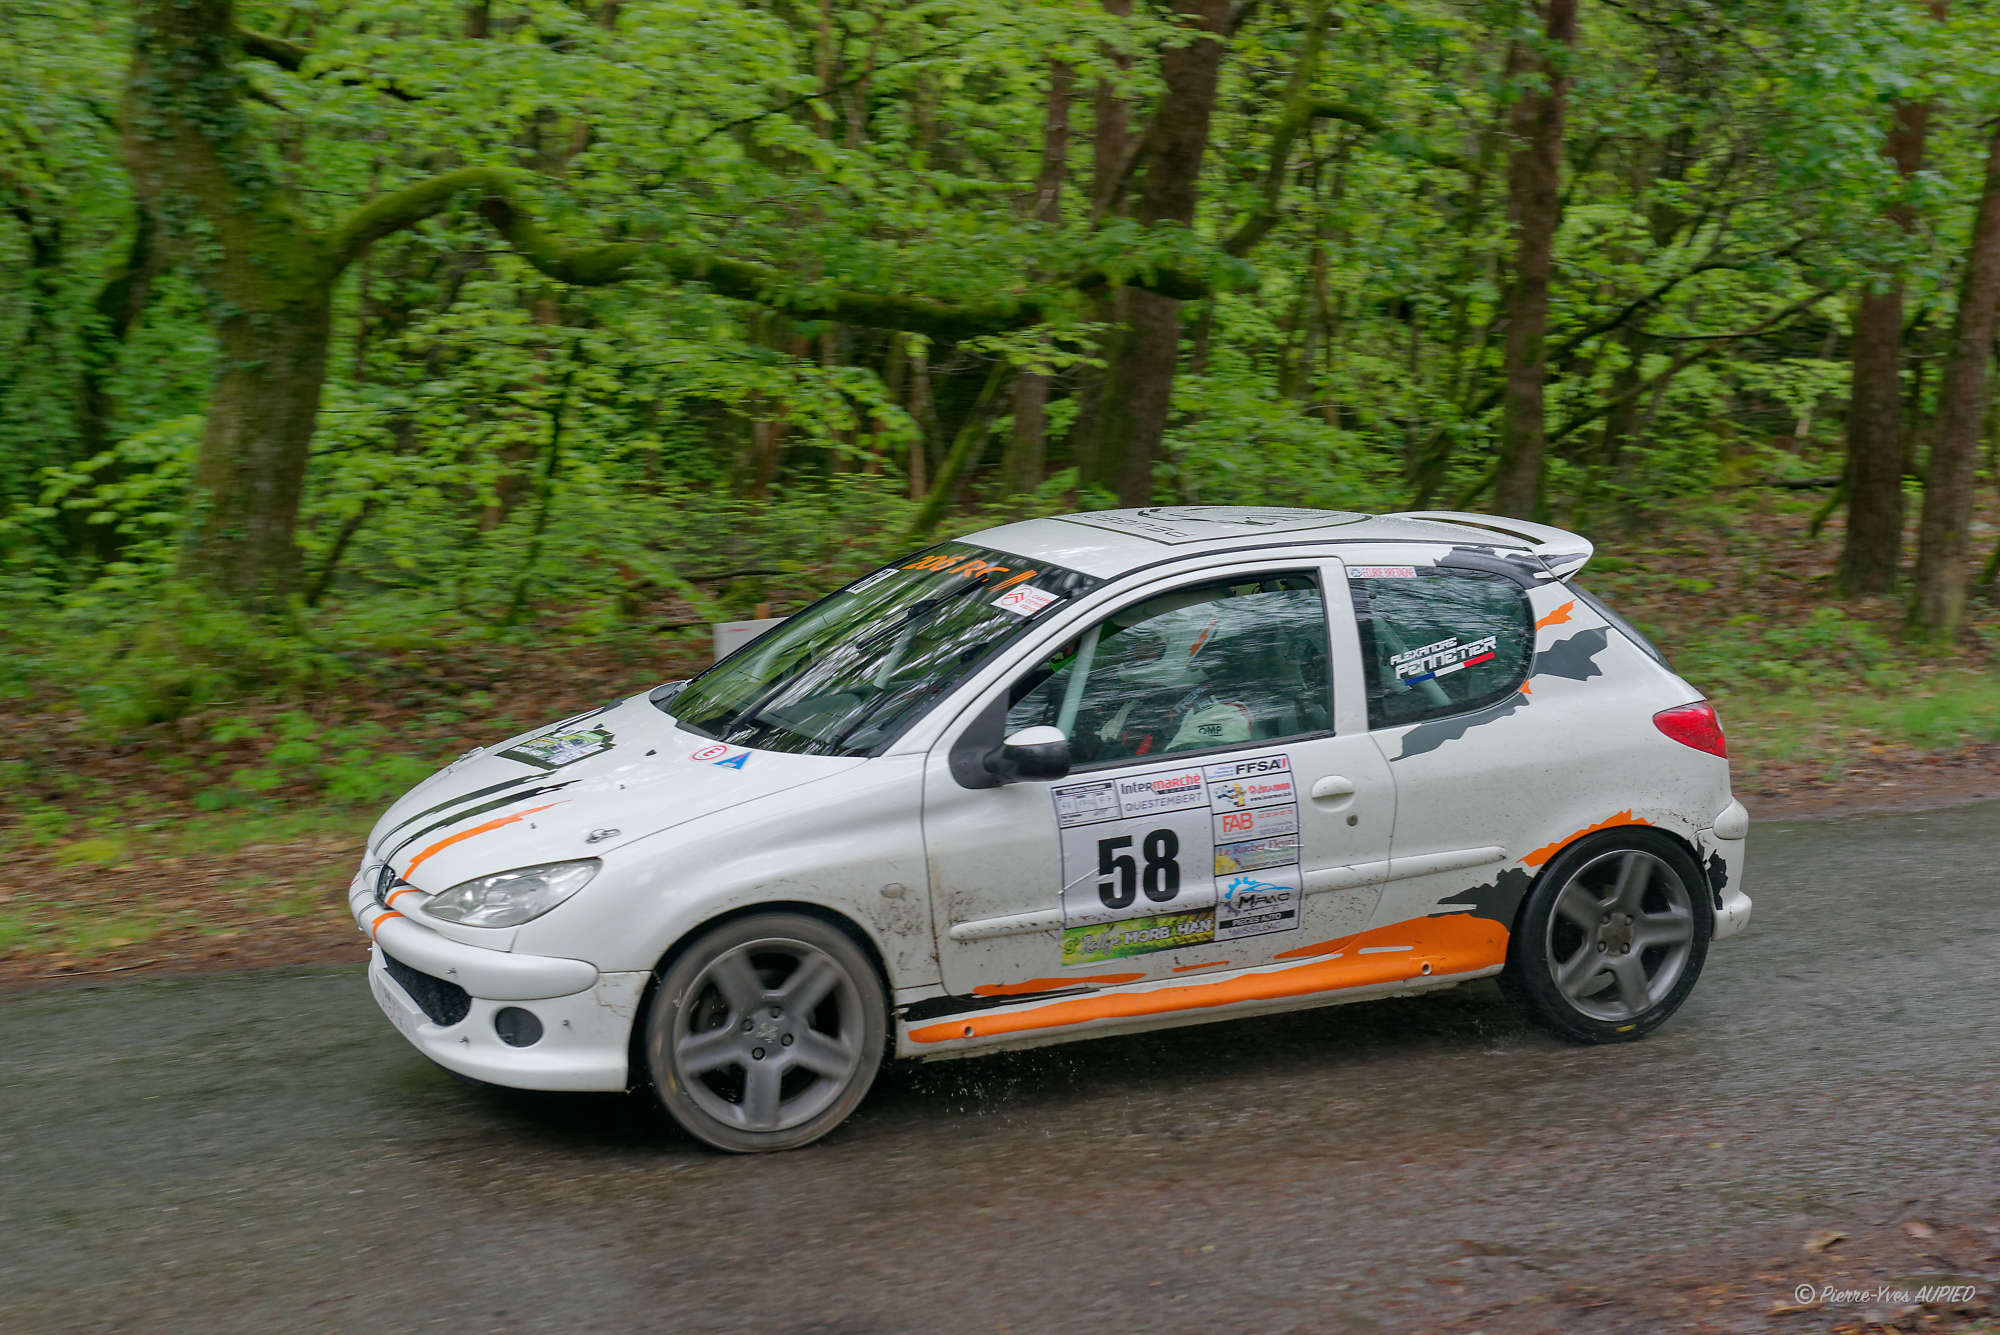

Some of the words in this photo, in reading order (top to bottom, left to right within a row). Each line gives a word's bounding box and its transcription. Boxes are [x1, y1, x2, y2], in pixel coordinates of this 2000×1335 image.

[901, 555, 968, 572] 206
[1390, 636, 1457, 666] ALEXANDRE
[1395, 635, 1497, 680] PENNETIER
[1236, 759, 1282, 775] FFSA
[1125, 793, 1202, 812] QUESTEMBERT
[1222, 812, 1254, 833] FAB
[1098, 829, 1180, 910] 58
